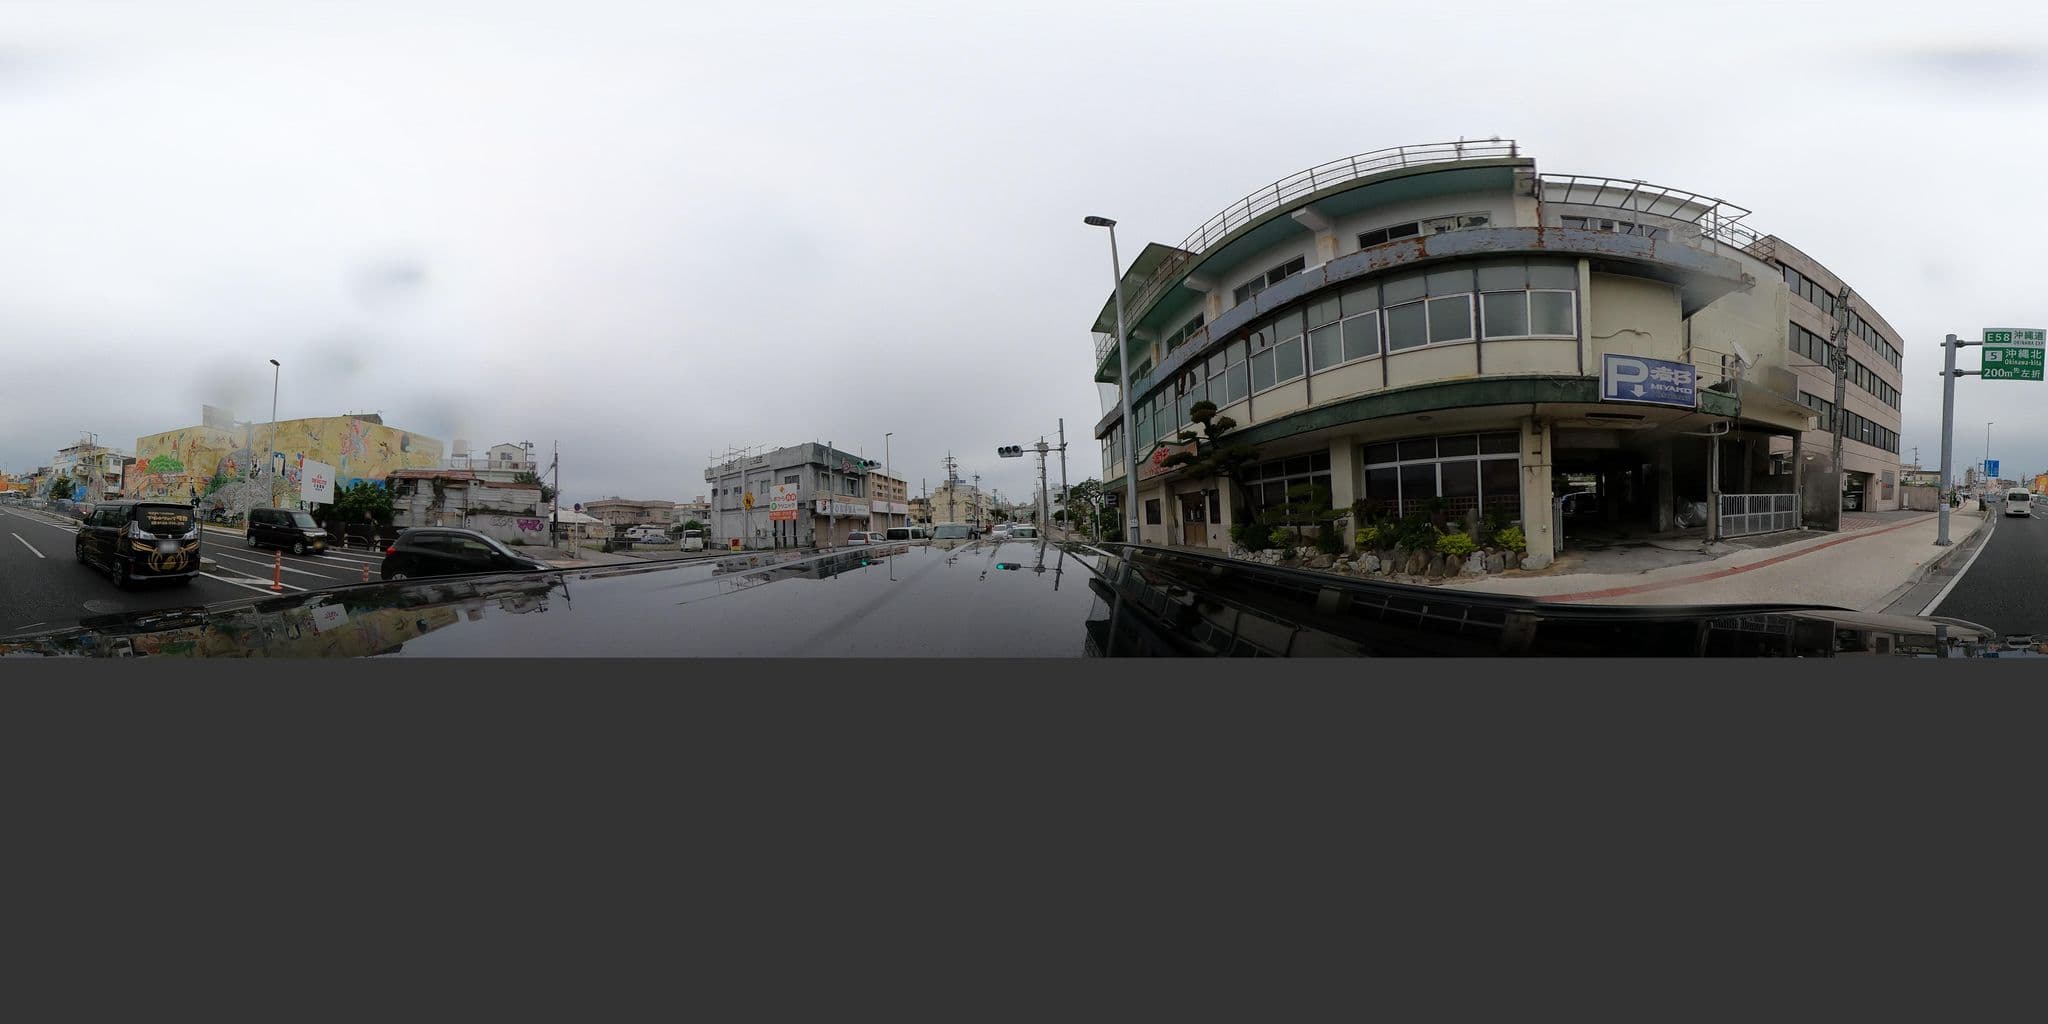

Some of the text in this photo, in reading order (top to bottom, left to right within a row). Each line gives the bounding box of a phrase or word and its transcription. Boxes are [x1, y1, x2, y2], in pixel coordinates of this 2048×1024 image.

[1987, 333, 2010, 342] E58
[2014, 330, 2043, 340] 沖縄道
[1991, 352, 1997, 360] 5
[2005, 349, 2042, 359] 沖縄北
[1607, 357, 1649, 396] P
[1650, 383, 1693, 395] MIYAKO
